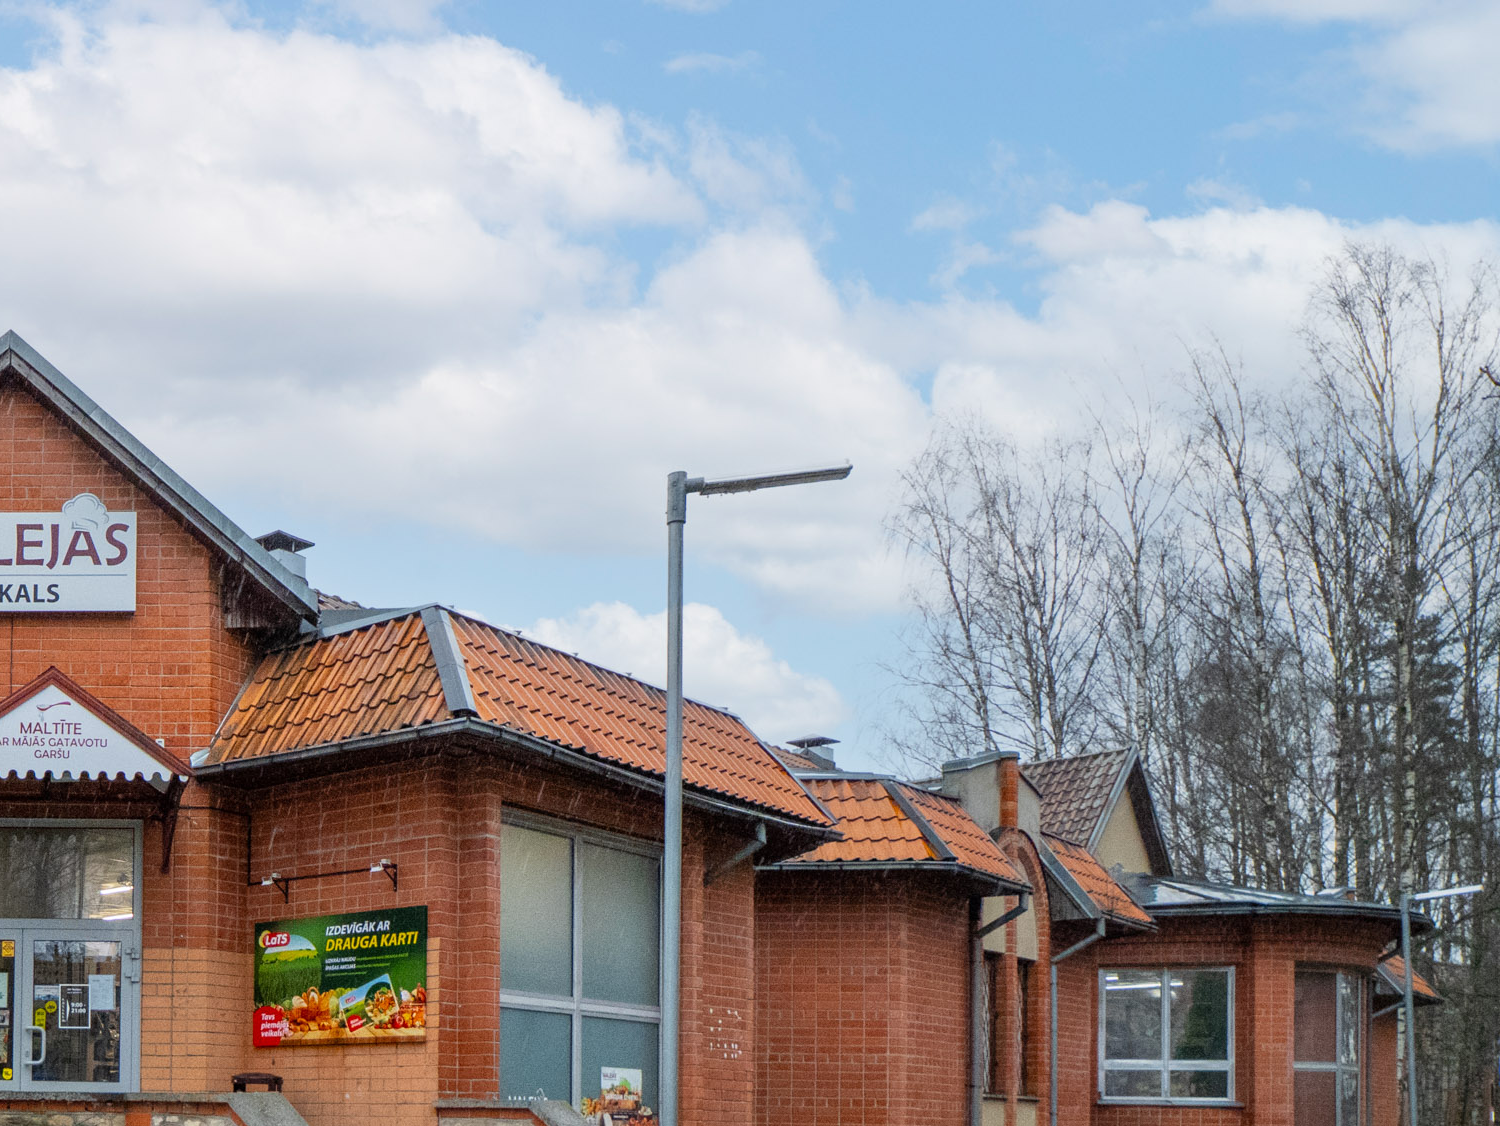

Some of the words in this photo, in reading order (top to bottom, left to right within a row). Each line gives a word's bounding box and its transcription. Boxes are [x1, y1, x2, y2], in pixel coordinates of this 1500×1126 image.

[19, 719, 83, 735] MALTĪTE
[11, 735, 46, 748] MĀJĀS
[48, 737, 108, 748] GATAVOTU
[34, 747, 70, 760] GARŠU
[325, 921, 375, 936] IZDEVĪGĀK
[376, 920, 391, 932] AR
[325, 934, 378, 952] DRAUGA
[380, 931, 419, 948] KARTI
